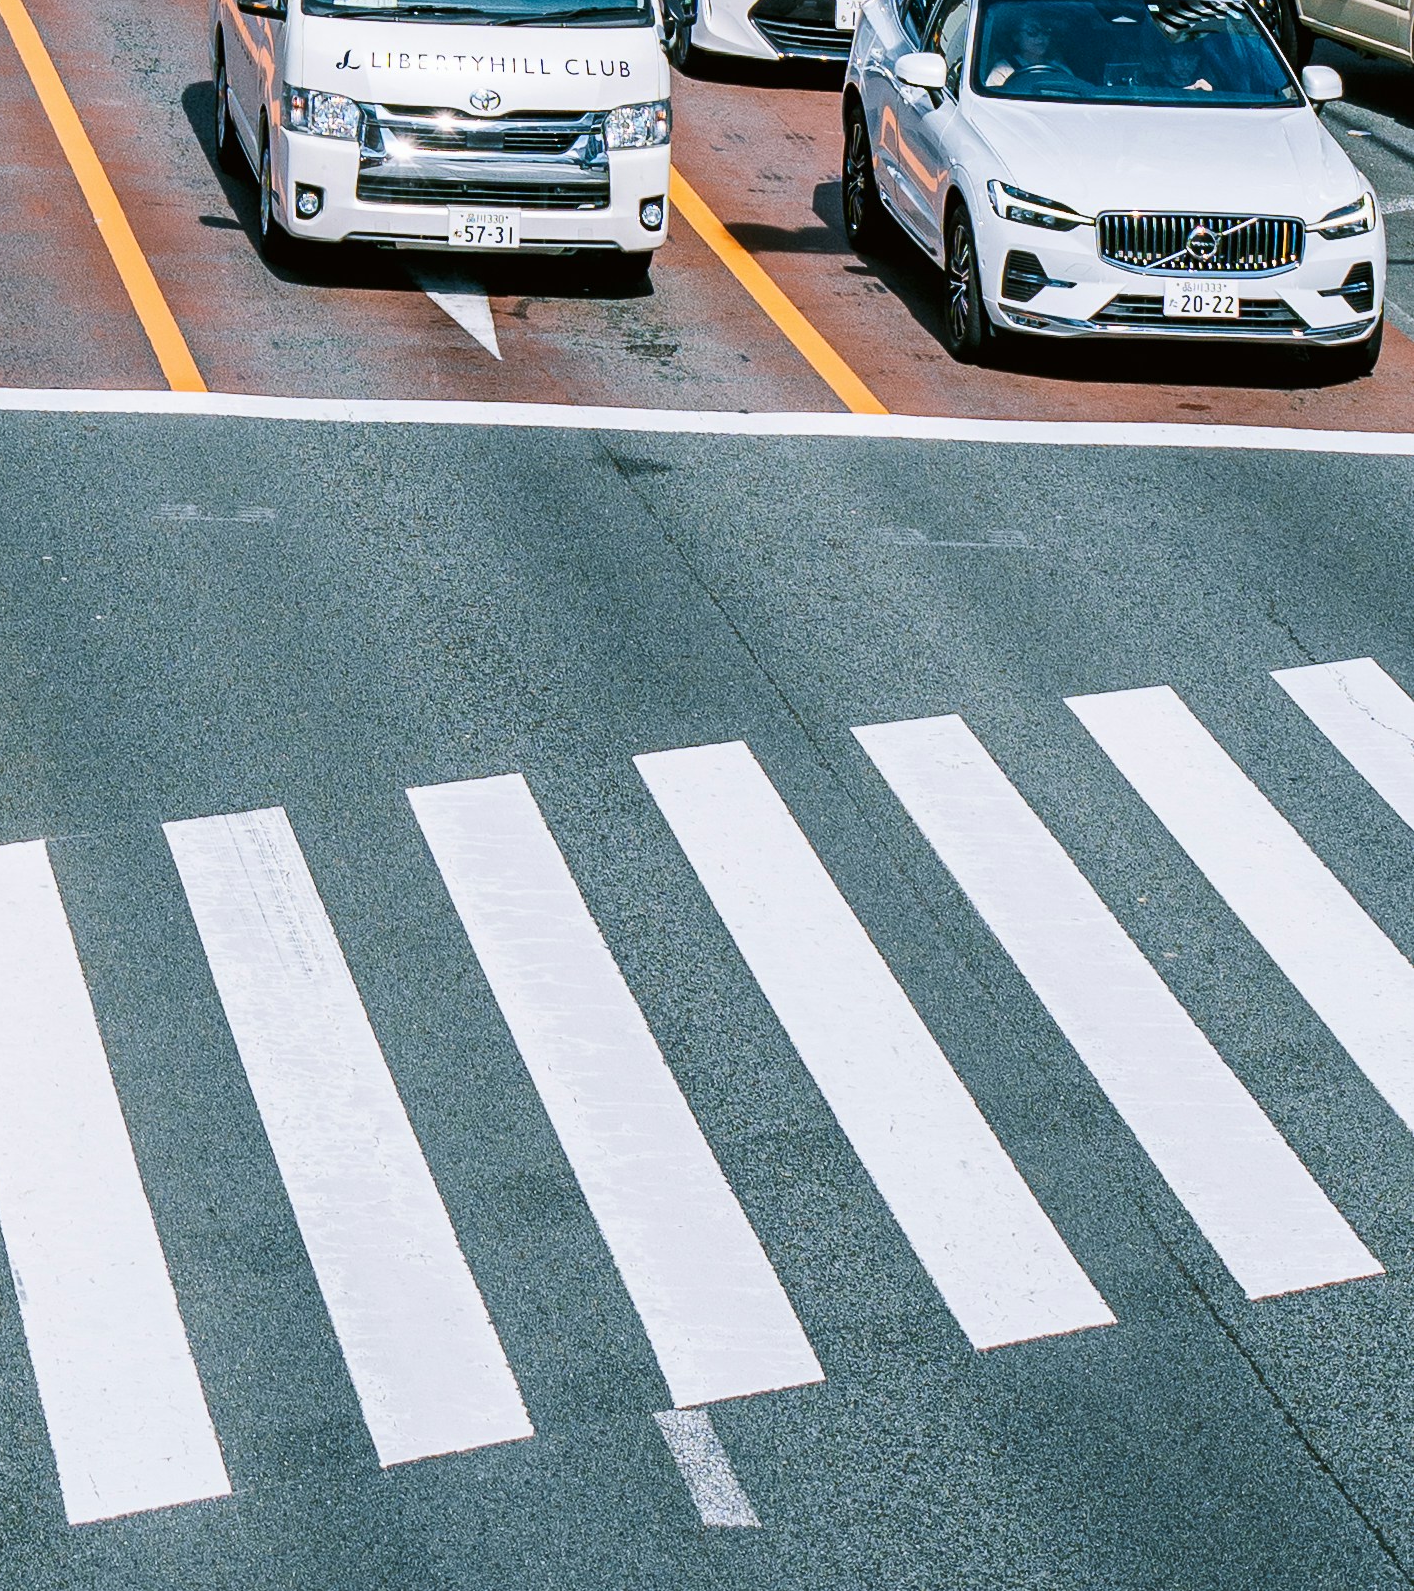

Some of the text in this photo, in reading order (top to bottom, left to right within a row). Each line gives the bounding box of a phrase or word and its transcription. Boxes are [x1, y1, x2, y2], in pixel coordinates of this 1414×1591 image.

[564, 58, 631, 78] CLUB
[464, 225, 513, 244] 57-31
[1181, 294, 1234, 314] 20-22
